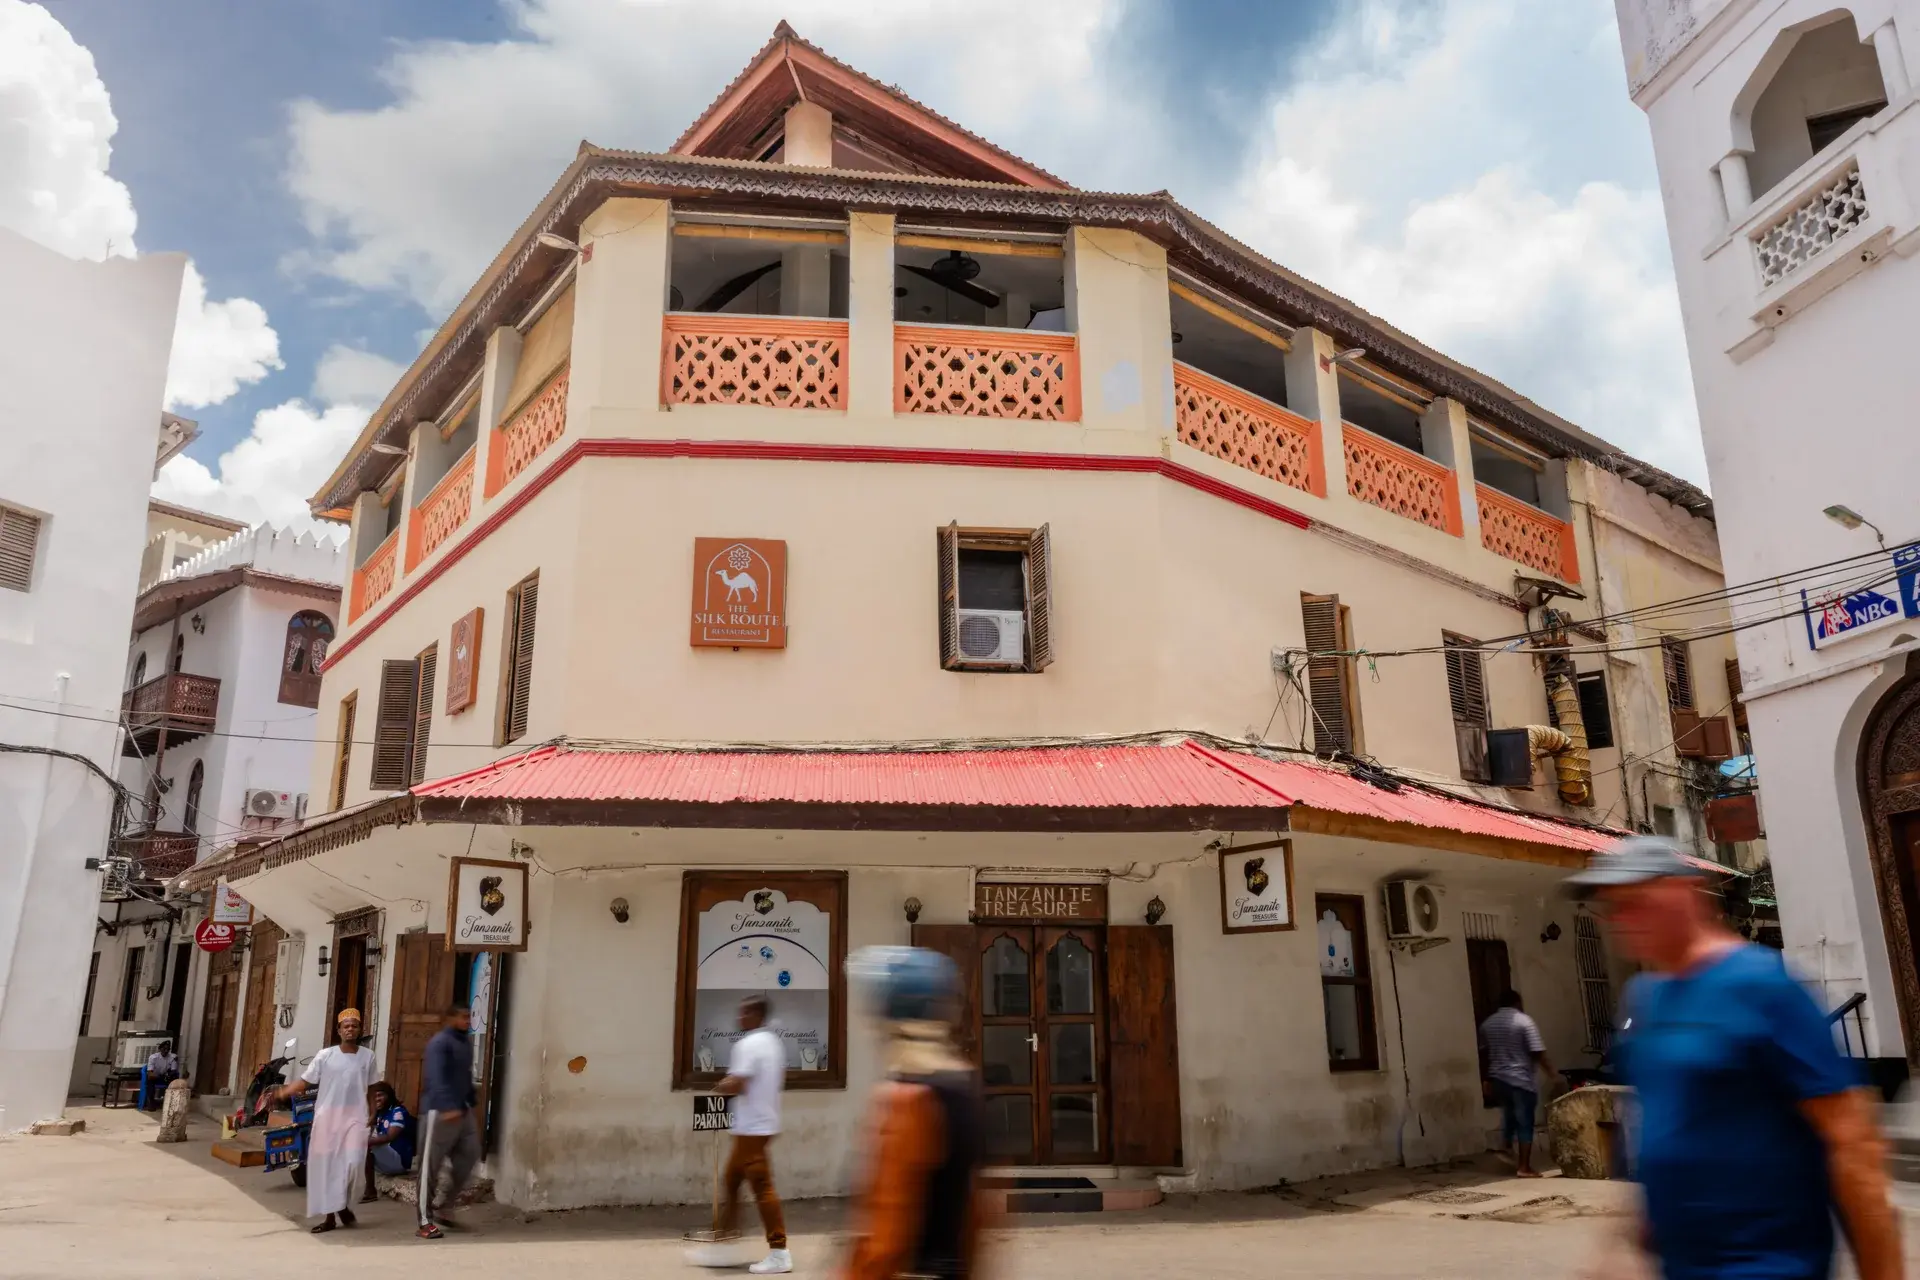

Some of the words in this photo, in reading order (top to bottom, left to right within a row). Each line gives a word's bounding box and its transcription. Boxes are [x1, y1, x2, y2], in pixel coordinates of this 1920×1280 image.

[728, 604, 748, 613] THE
[1855, 599, 1892, 626] NBC
[694, 612, 726, 625] SILK
[730, 613, 780, 626] ROUTE
[711, 628, 761, 636] RESTAURANT
[982, 886, 1092, 902] TANZANITE
[982, 901, 1080, 916] TREASURE
[1233, 897, 1280, 920] Tanzanite
[461, 915, 515, 939] Tanzanite
[731, 913, 794, 933] Tanzanite
[707, 1096, 725, 1112] NO
